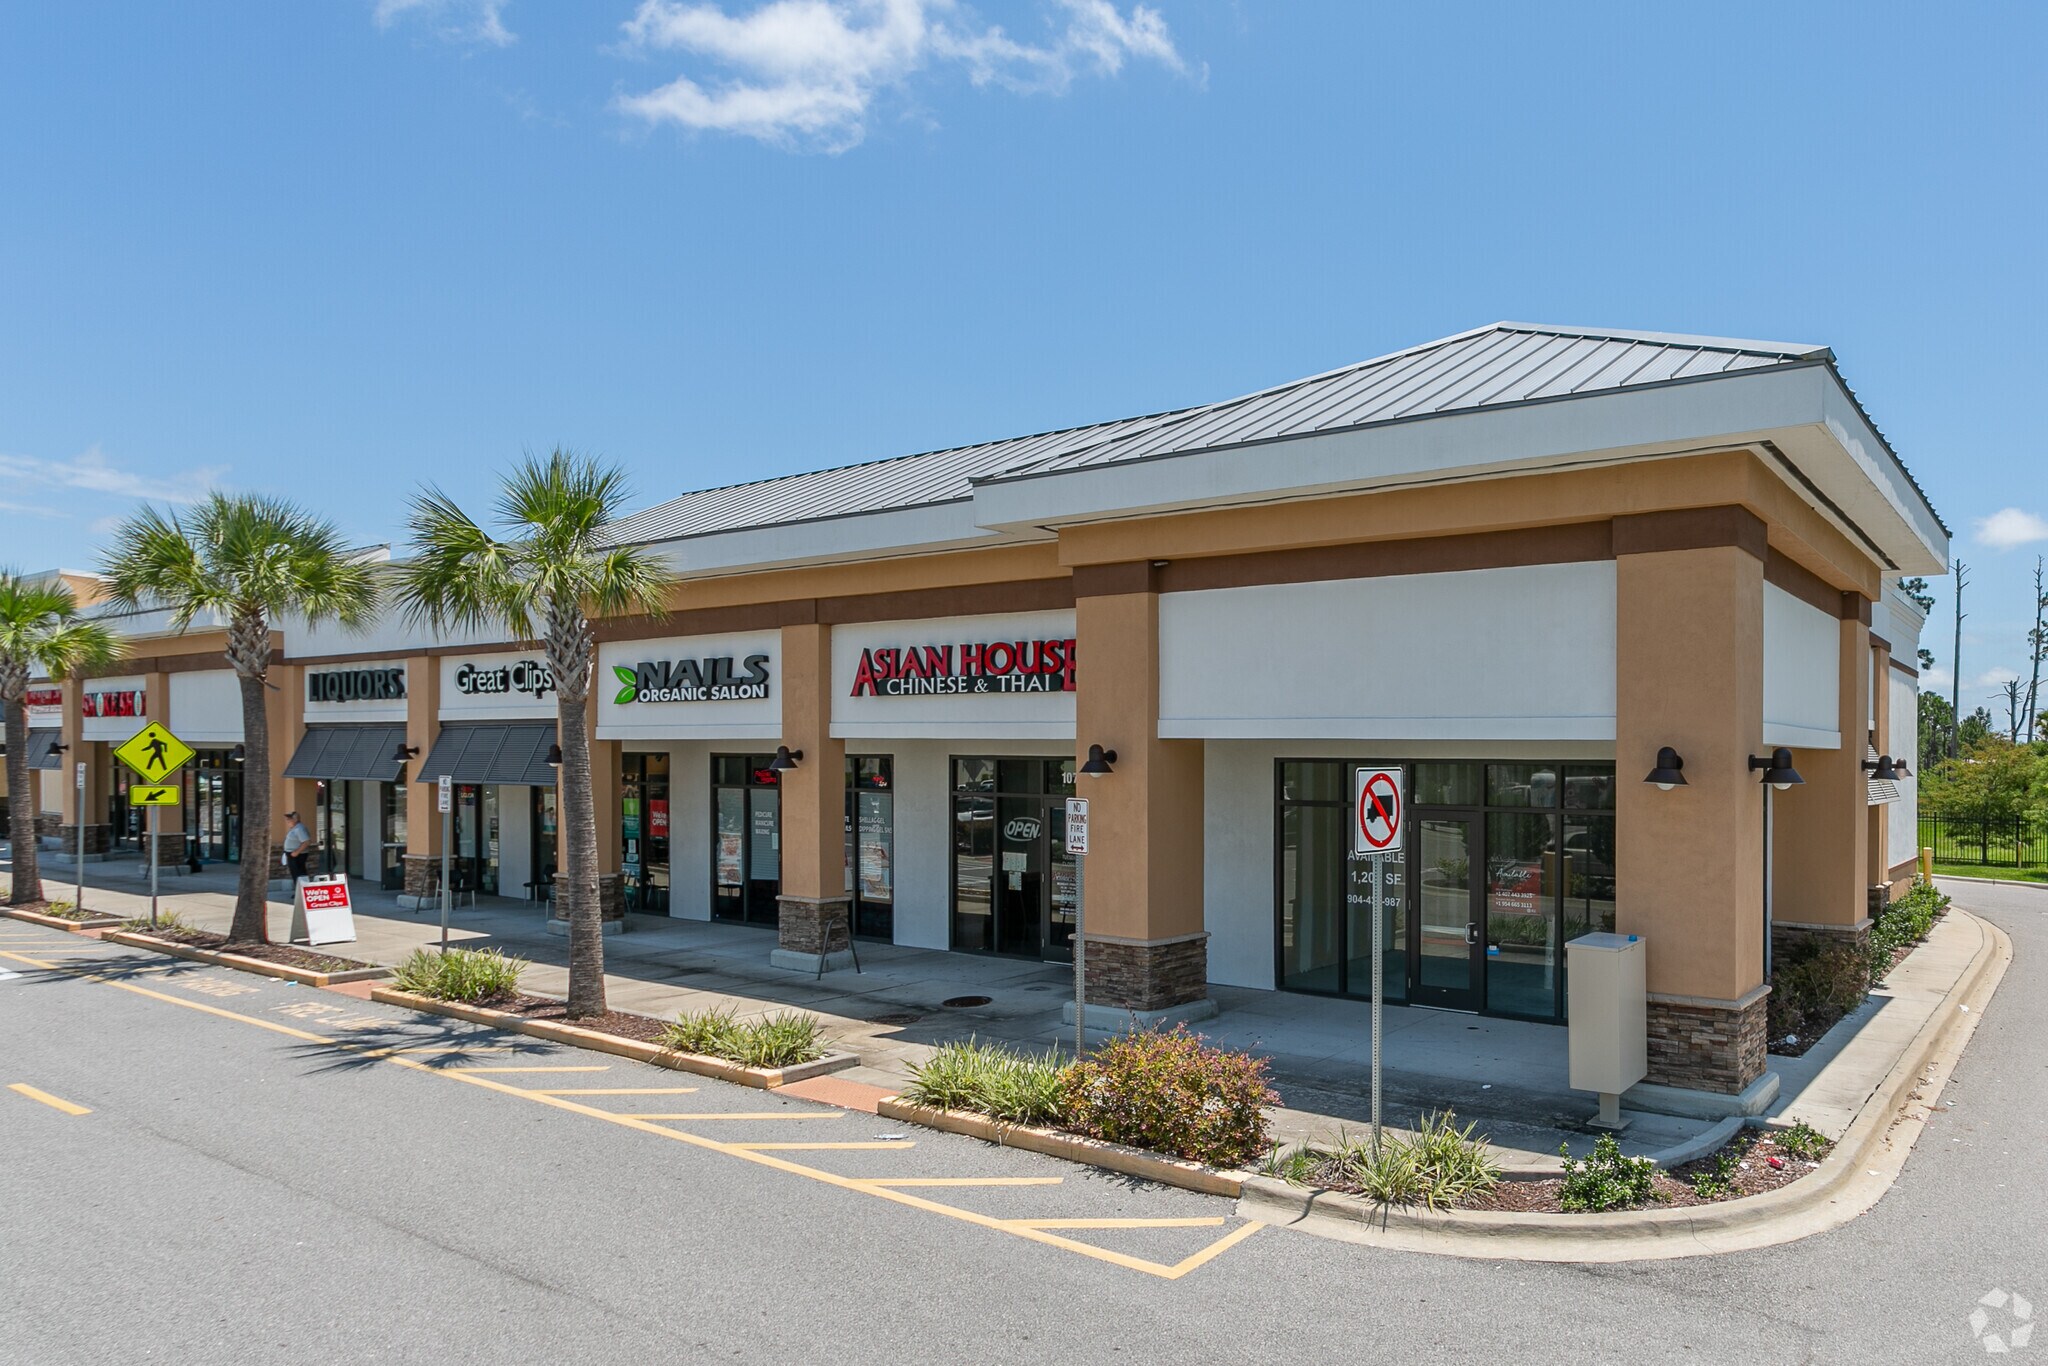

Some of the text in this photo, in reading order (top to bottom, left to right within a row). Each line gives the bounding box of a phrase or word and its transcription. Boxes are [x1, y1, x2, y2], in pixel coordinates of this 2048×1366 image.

[455, 660, 556, 699] Great Clips
[637, 654, 769, 688] NAILS
[850, 645, 956, 696] ASIAN
[309, 668, 405, 703] LIQUORS
[639, 684, 765, 703] ORGANIC SALON
[886, 674, 1051, 695] CHINESE & THAI
[1073, 802, 1082, 813] NO
[1068, 813, 1087, 824] PARKING
[1006, 820, 1040, 839] OPEN
[1070, 824, 1084, 834] FIRE
[1069, 835, 1085, 844] LANE
[1351, 870, 1402, 886] 1,20 SF
